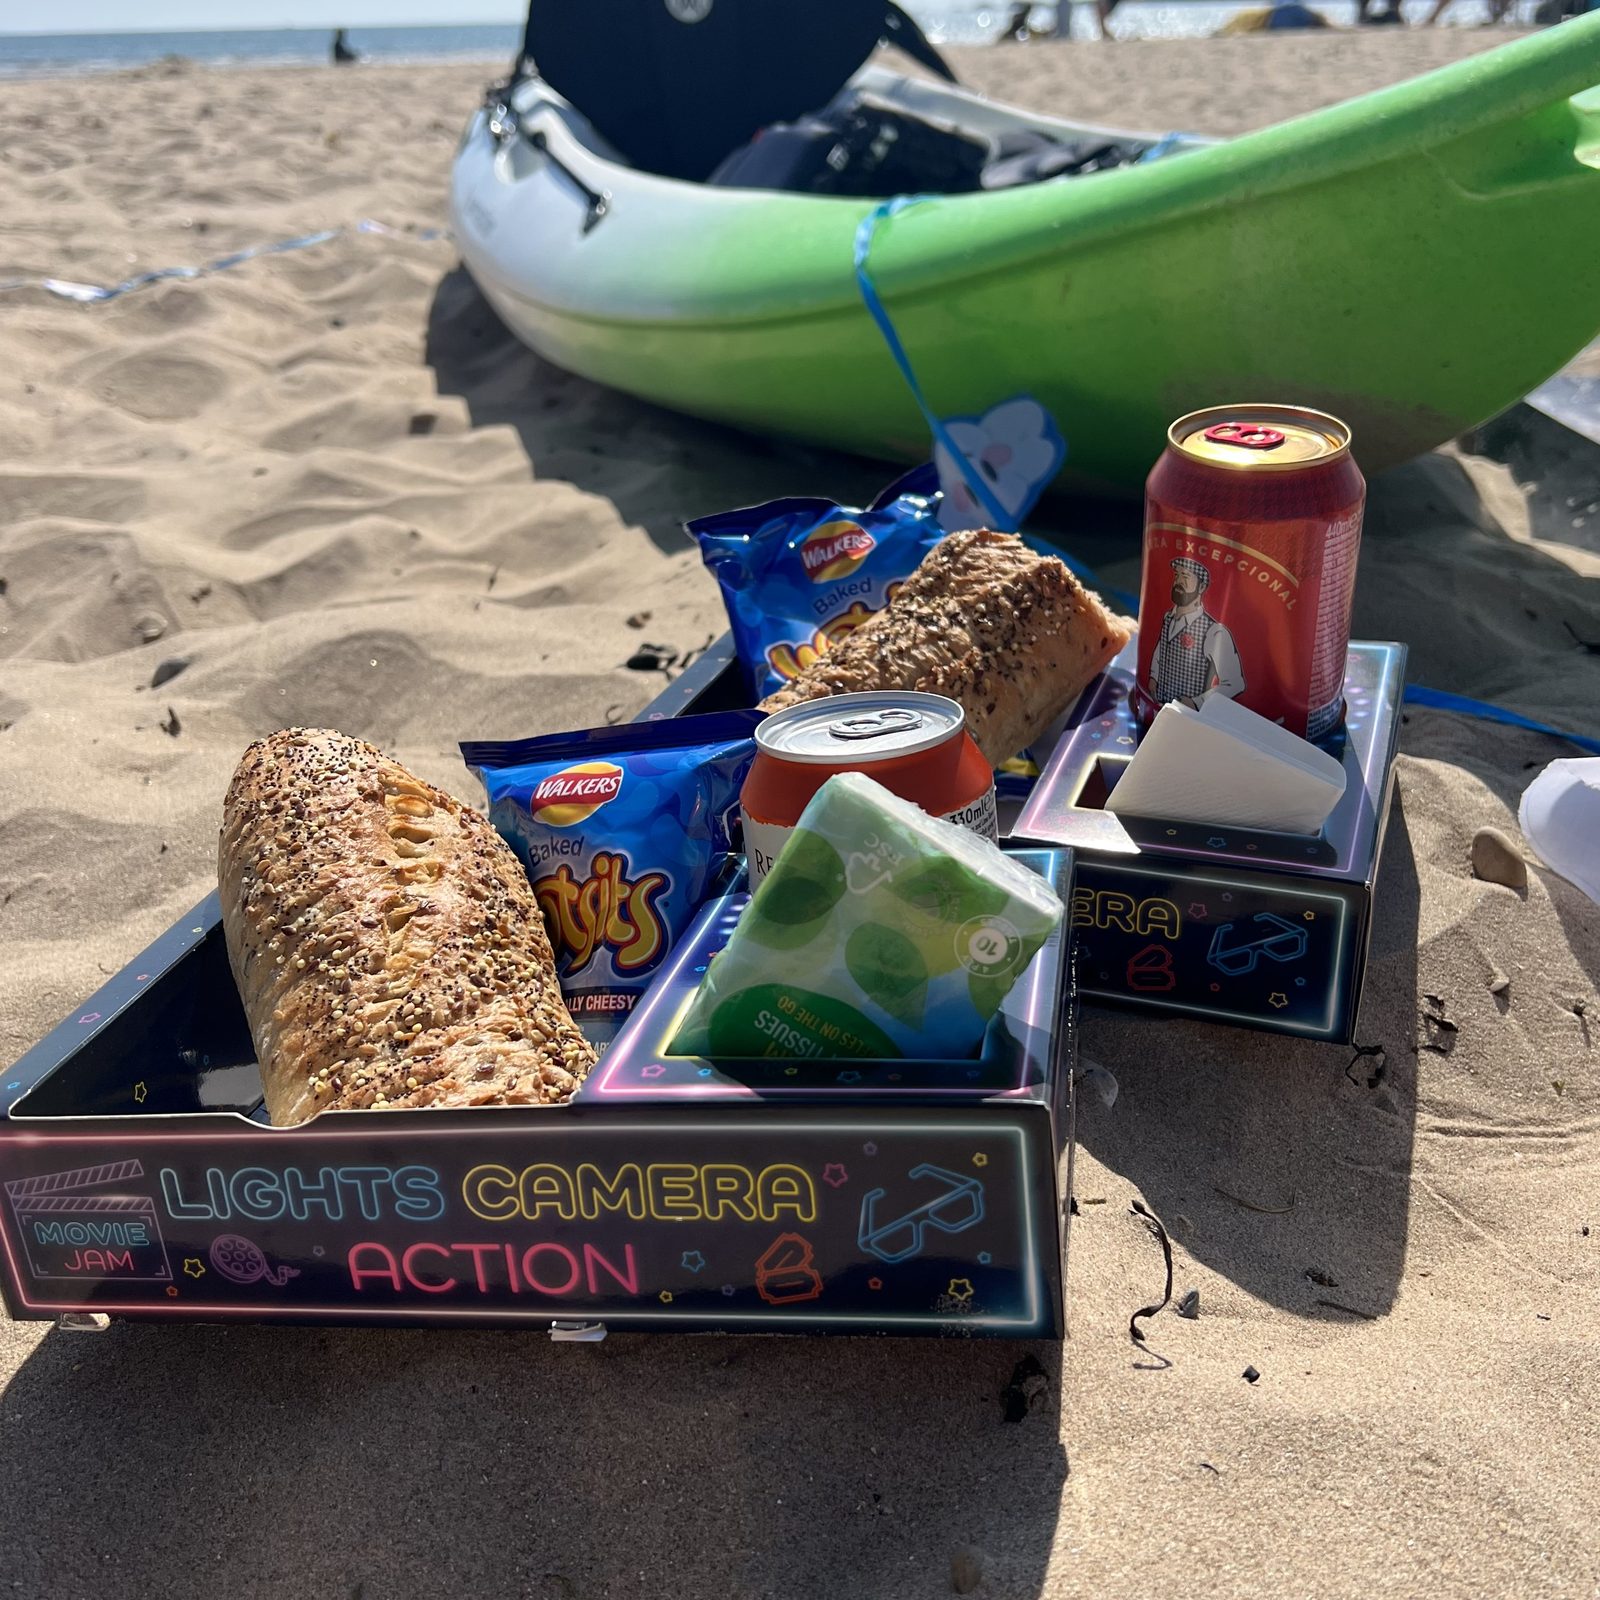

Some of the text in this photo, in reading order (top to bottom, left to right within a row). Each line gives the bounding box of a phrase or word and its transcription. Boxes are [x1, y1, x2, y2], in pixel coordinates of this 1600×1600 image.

[802, 533, 876, 569] WALKERS
[1175, 540, 1297, 611] EXCEPCIONAL
[812, 577, 872, 615] Baked
[533, 774, 622, 800] WALKERS
[529, 836, 584, 866] Baked
[975, 936, 998, 956] 10
[586, 994, 636, 1011] CHEESY
[776, 995, 798, 1016] GO
[794, 1007, 818, 1031] THE
[819, 1021, 841, 1042] ON
[160, 1163, 816, 1222] LIGHTS CAMERA
[33, 1221, 151, 1247] MOVIE
[64, 1249, 135, 1272] JAM
[347, 1242, 639, 1295] ACTION
